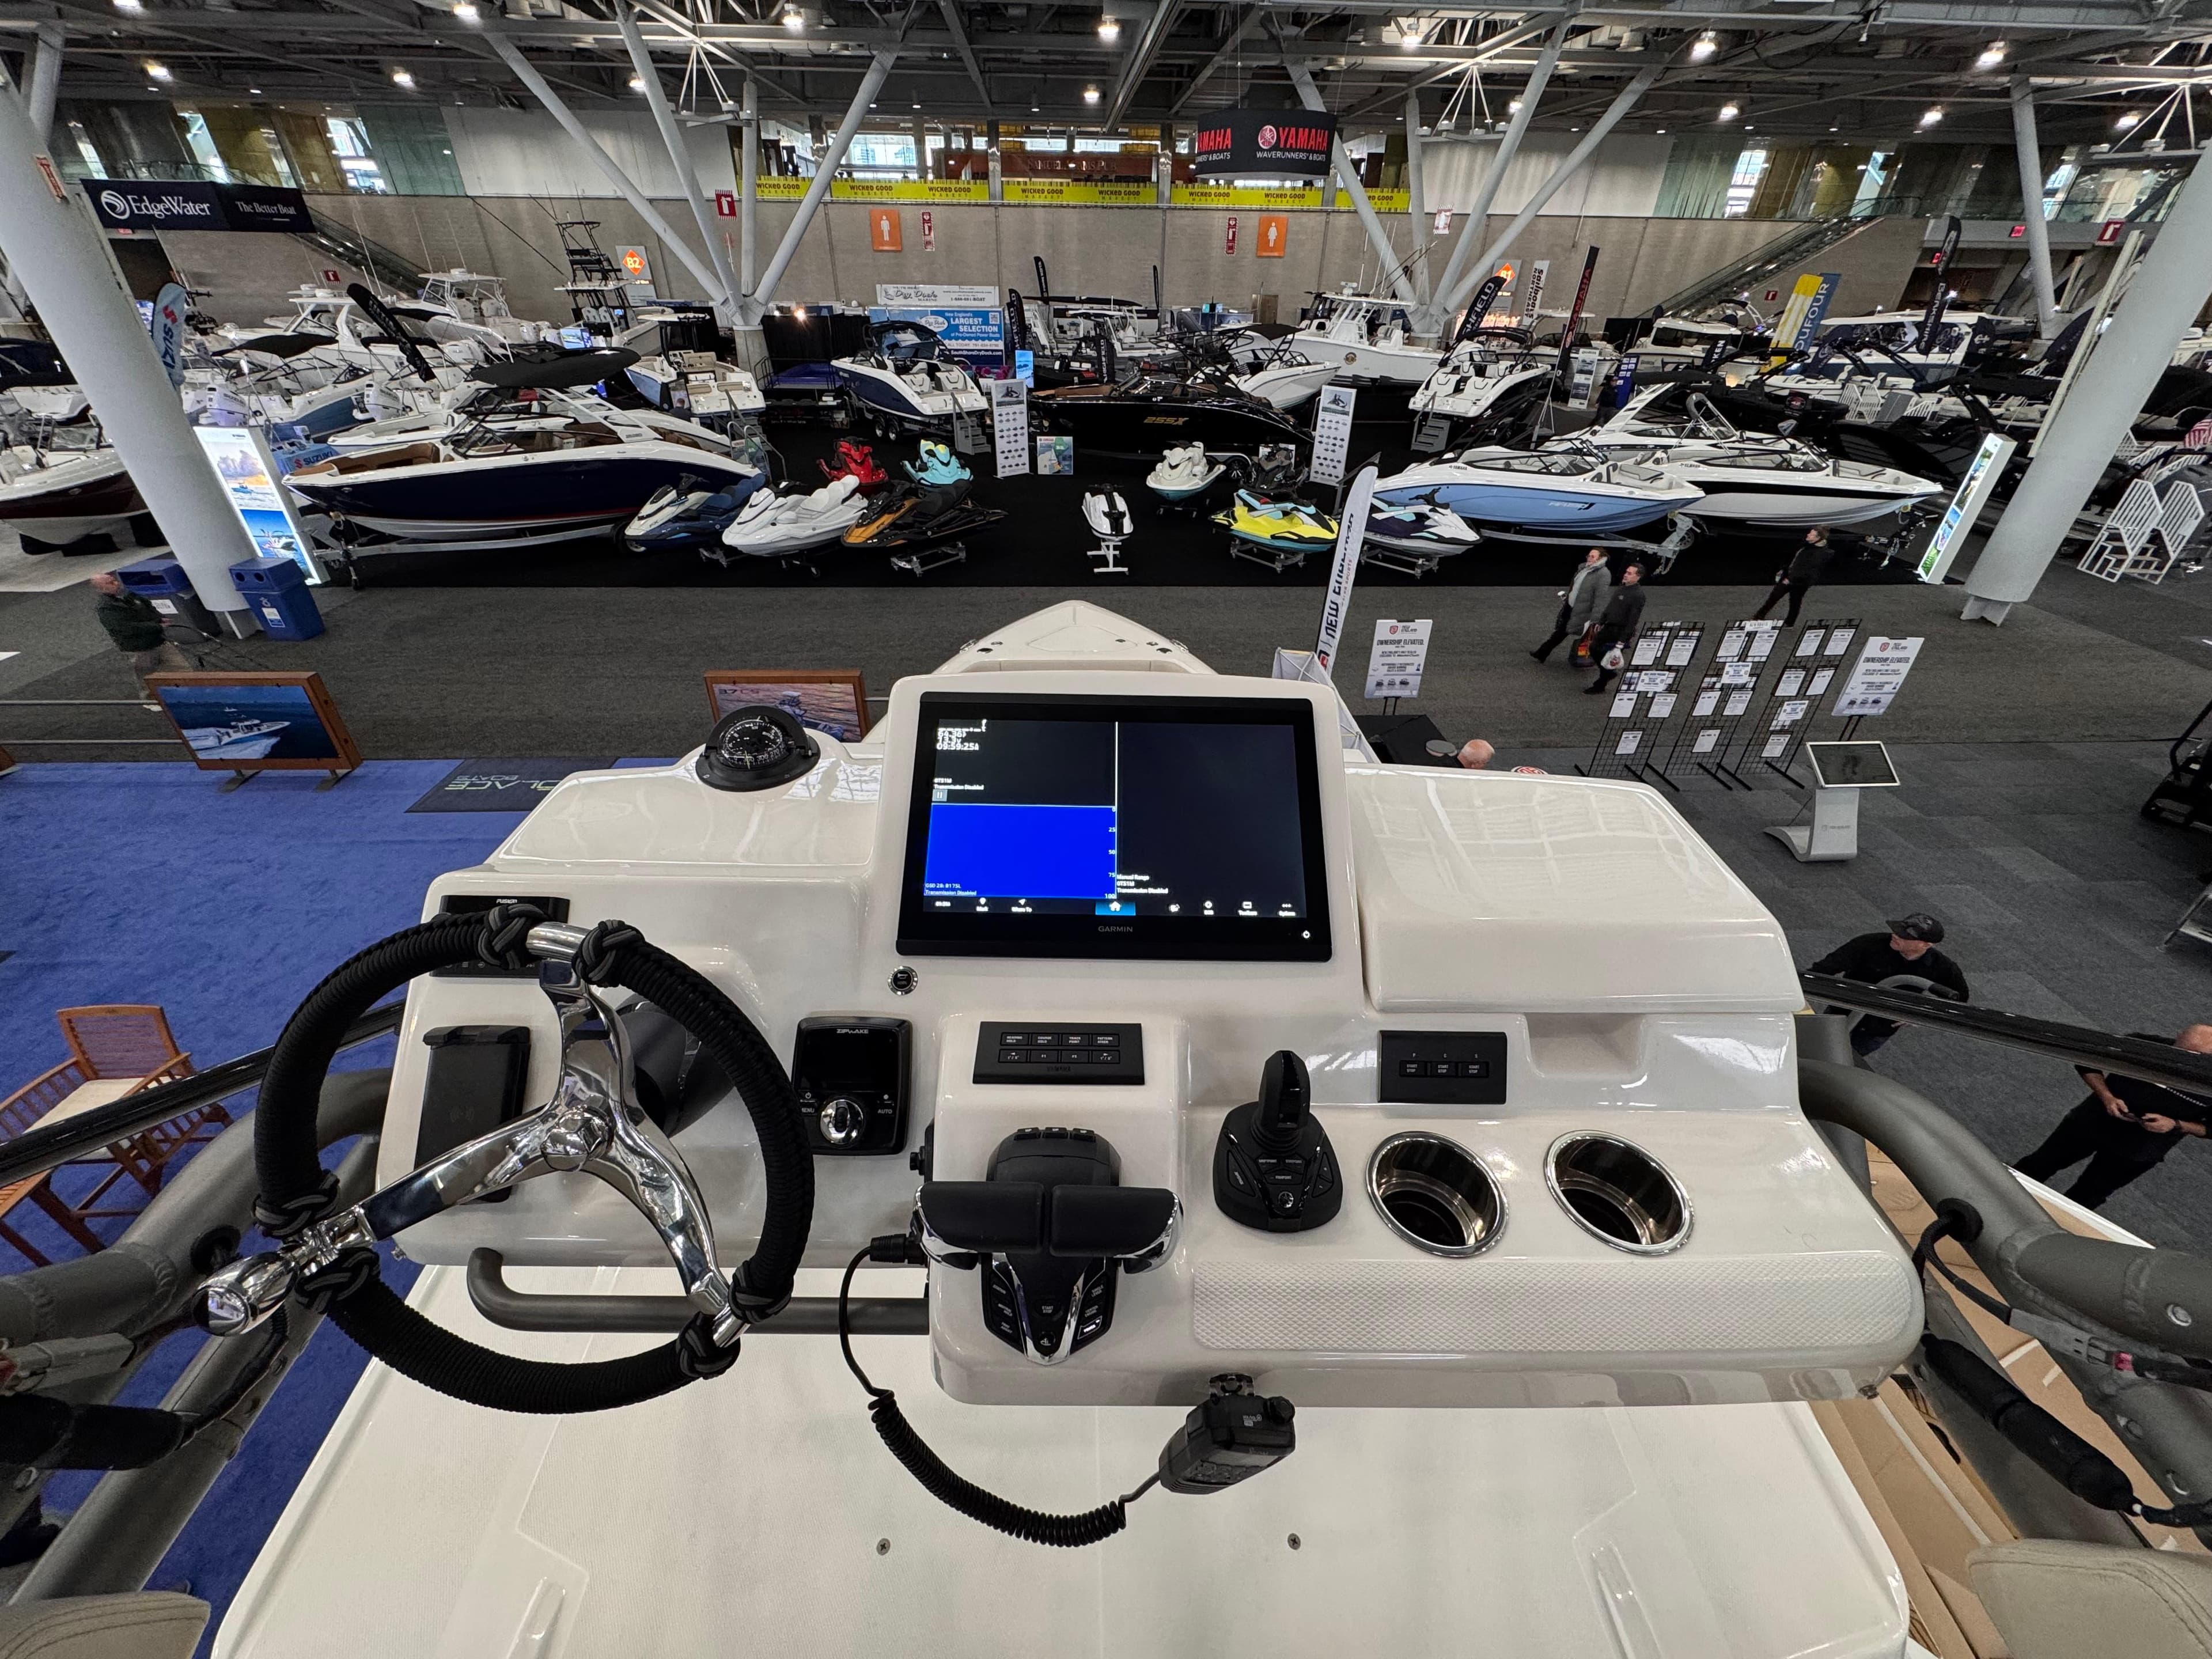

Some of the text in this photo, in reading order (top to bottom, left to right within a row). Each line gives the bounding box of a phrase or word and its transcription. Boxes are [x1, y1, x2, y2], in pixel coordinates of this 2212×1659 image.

[1279, 127, 1328, 151] YAMAHA
[1213, 152, 1231, 160] BOATS
[1313, 154, 1326, 162] BOATS
[127, 195, 211, 219] EdgeWater
[236, 201, 297, 215] The Better Boat
[626, 257, 641, 268] B2
[1524, 267, 1537, 317] NORTHEAST
[1796, 282, 1830, 351] DUFOUR
[1009, 308, 1021, 350] HFIELD
[1344, 559, 1354, 586] SPORTS
[445, 779, 561, 791] OLACE
